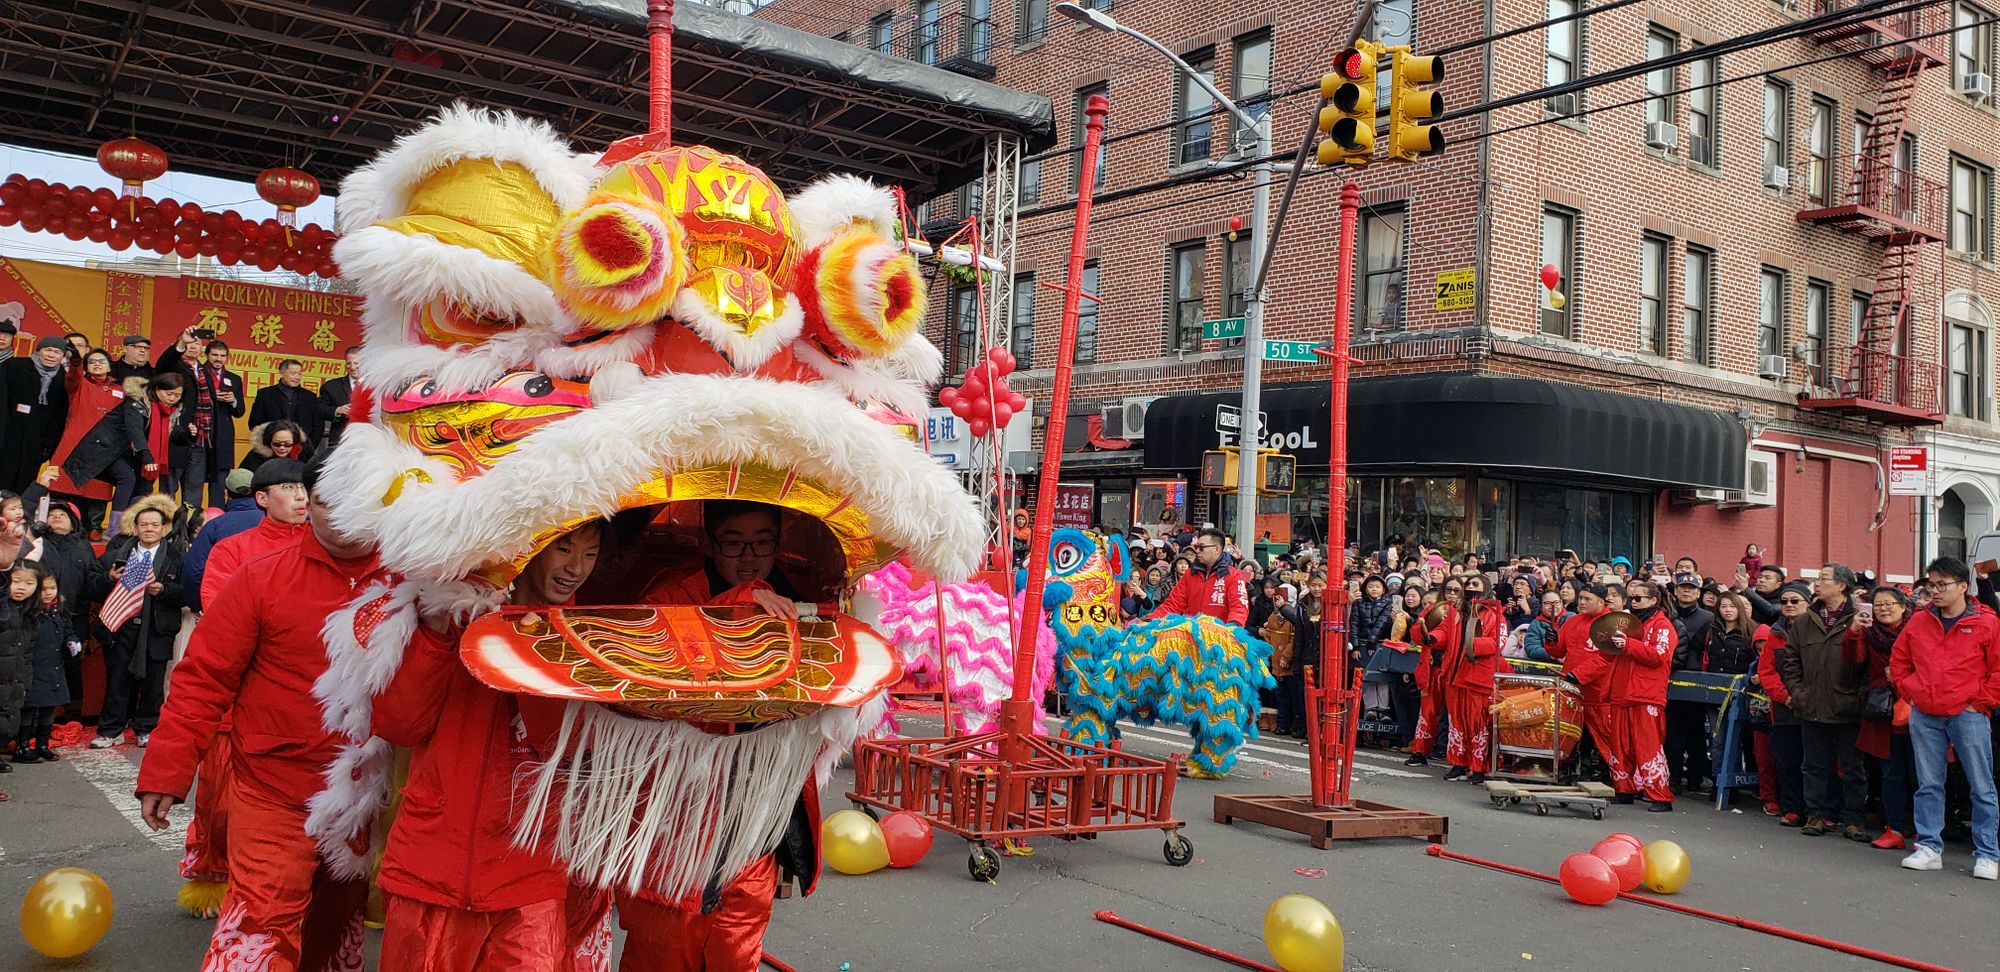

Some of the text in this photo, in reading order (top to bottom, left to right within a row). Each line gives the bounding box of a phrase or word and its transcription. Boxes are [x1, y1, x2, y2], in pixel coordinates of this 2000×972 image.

[1438, 281, 1474, 298] ZANIS
[187, 279, 351, 316] BROOKLYN CHINESE
[1212, 321, 1237, 337] 8 AV
[1271, 343, 1310, 358] 50 ST
[320, 361, 341, 375] THE
[1221, 413, 1235, 425] ONE
[1358, 723, 1375, 731] LICE
